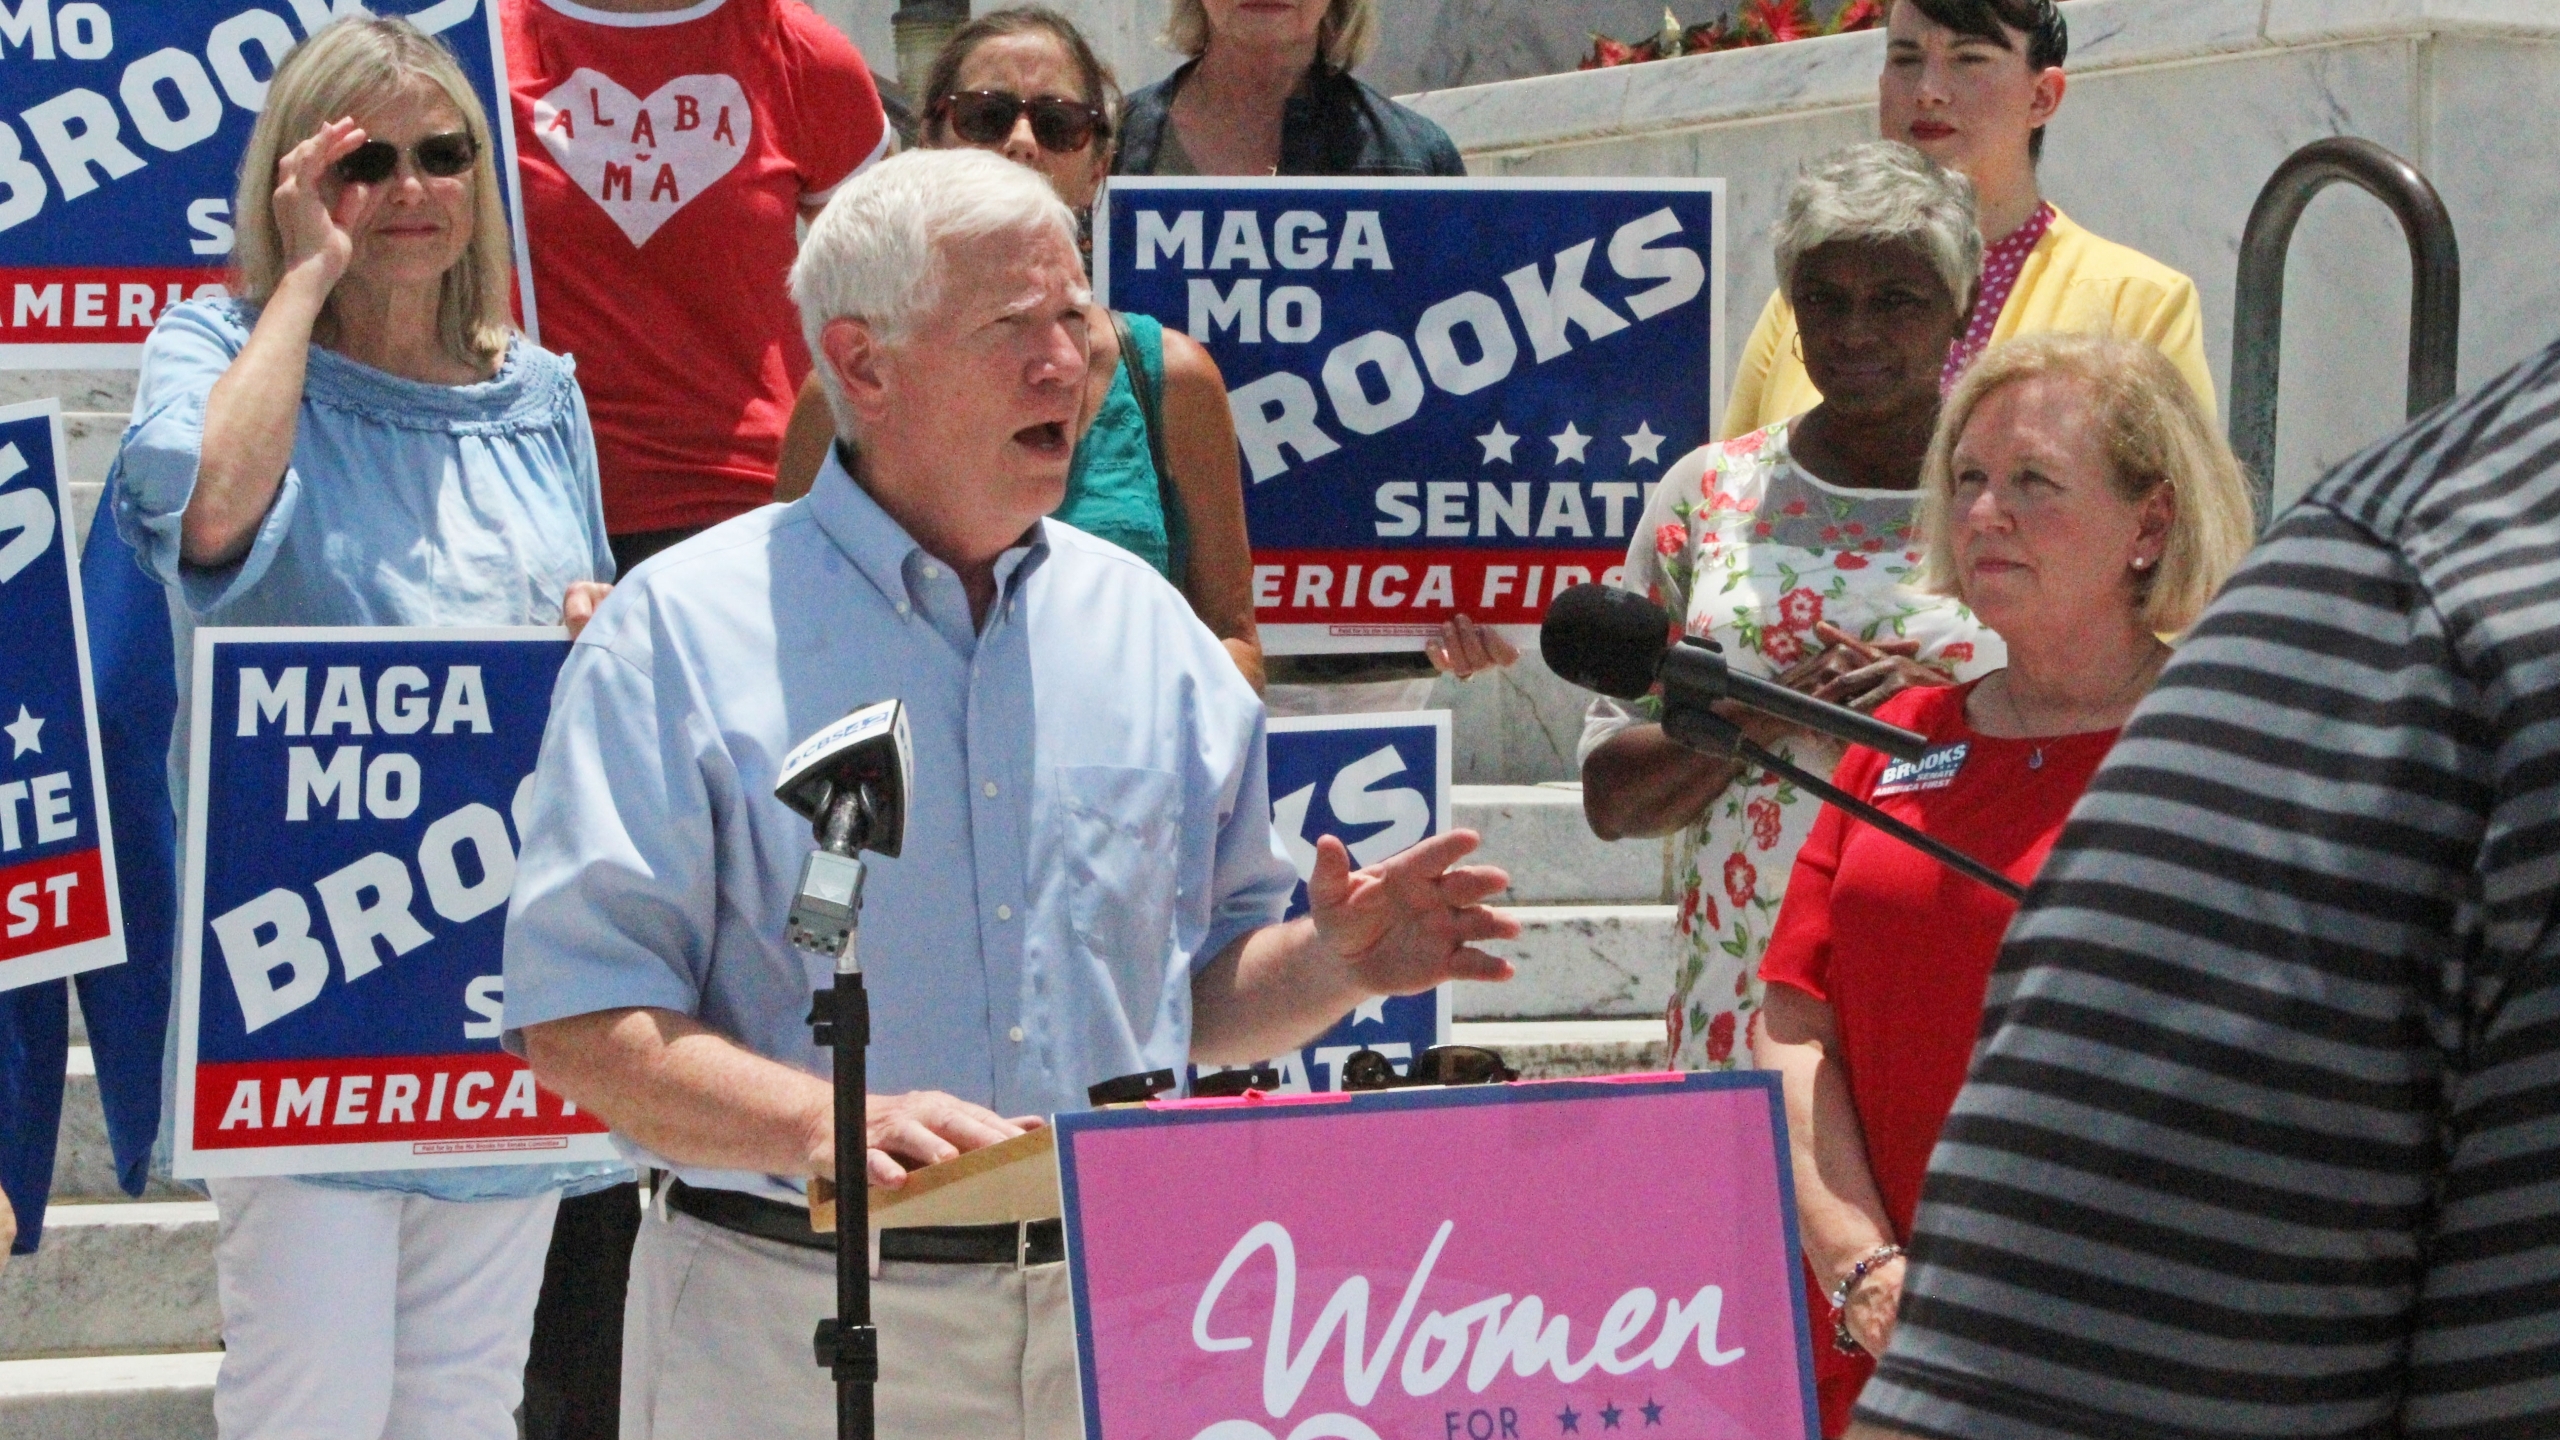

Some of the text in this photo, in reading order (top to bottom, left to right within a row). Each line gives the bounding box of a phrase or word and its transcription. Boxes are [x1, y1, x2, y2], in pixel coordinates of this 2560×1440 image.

[549, 88, 735, 148] ALABA
[602, 161, 679, 202] MA
[1135, 210, 1393, 271] MAGA
[1187, 279, 1322, 344] MO
[1228, 206, 1705, 484] ROOKS
[1375, 482, 1660, 537] SENAT
[1253, 565, 1457, 608] ERICA
[236, 665, 493, 737] MAGA
[286, 745, 421, 821] MO
[210, 771, 535, 1034] BRO
[218, 1069, 538, 1130] AMERICA
[1193, 1220, 1745, 1418] Women
[1445, 1407, 1519, 1440] FOR
